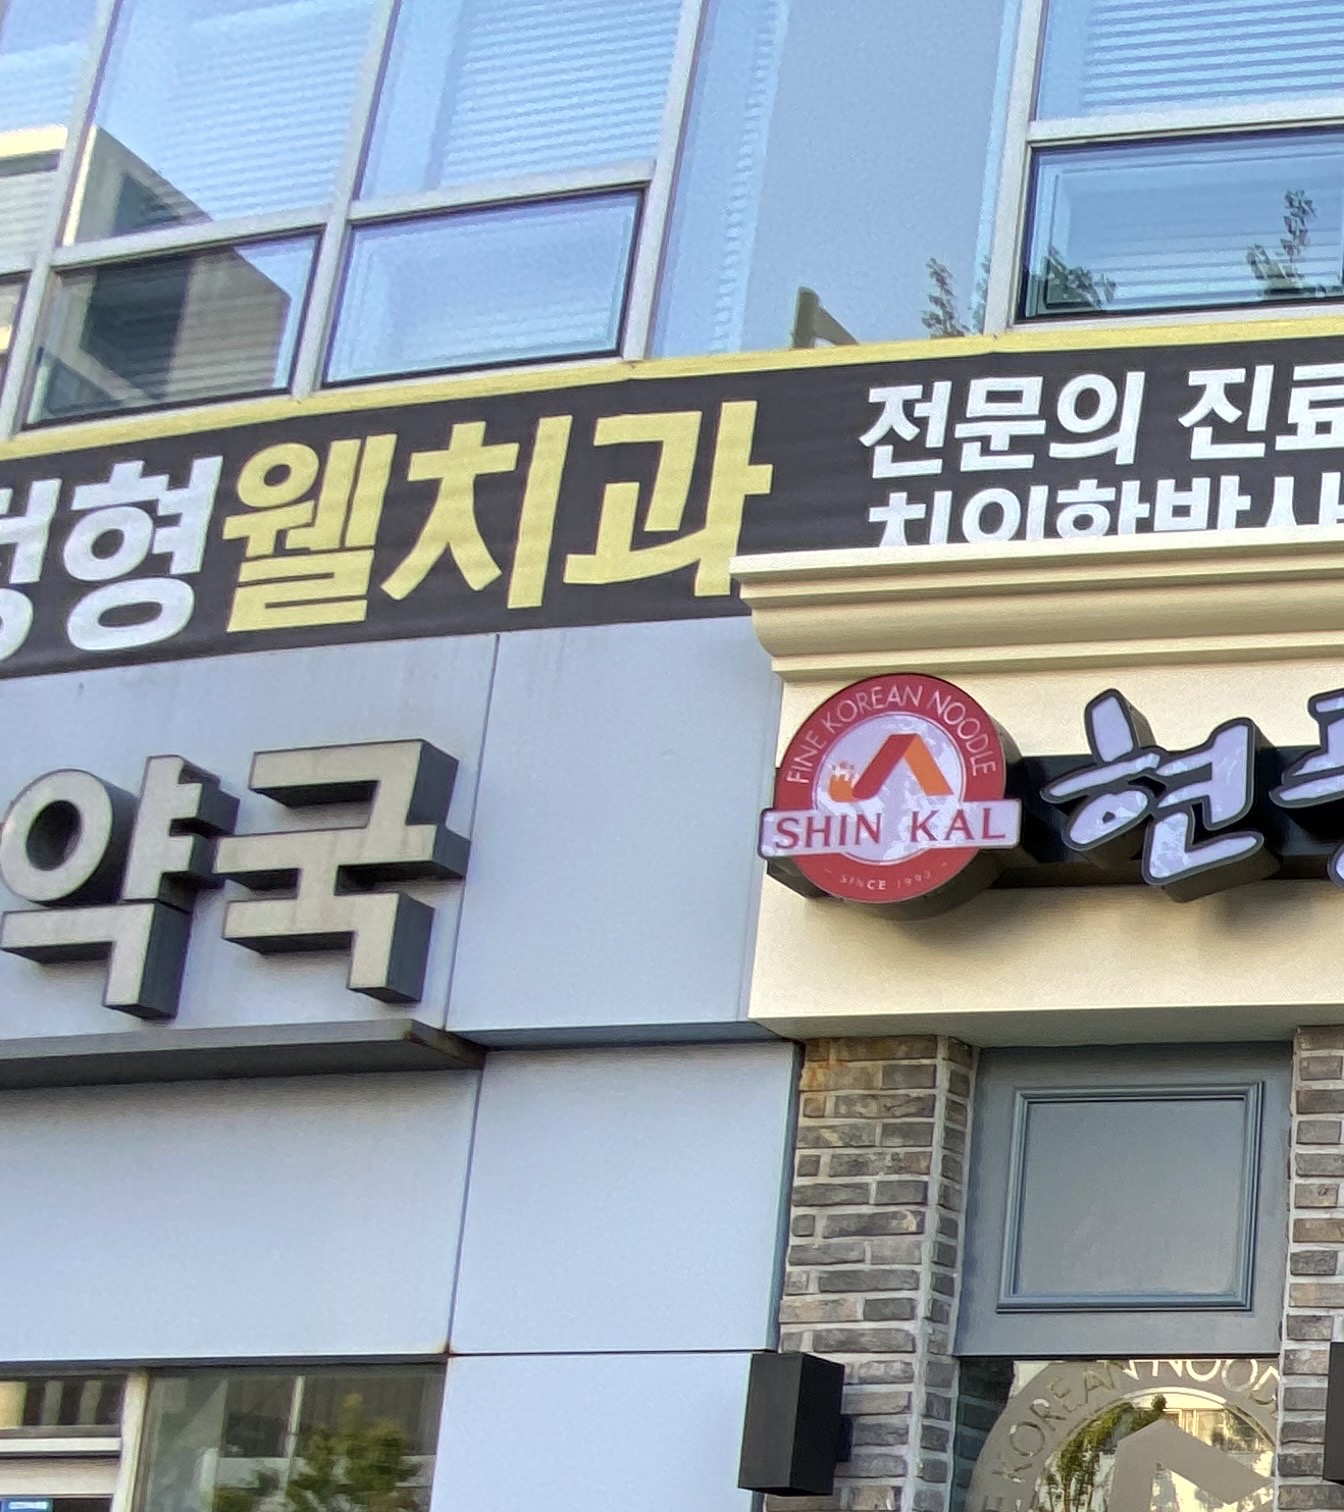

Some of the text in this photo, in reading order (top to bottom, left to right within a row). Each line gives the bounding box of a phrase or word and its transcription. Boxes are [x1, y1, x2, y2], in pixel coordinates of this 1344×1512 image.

[858, 371, 1147, 481] 전문의
[786, 684, 998, 785] FINE KOREAN NOODLE
[774, 807, 1007, 850] SHIN KAL
[0, 739, 470, 1021] 약국
[839, 874, 887, 891] SINCE
